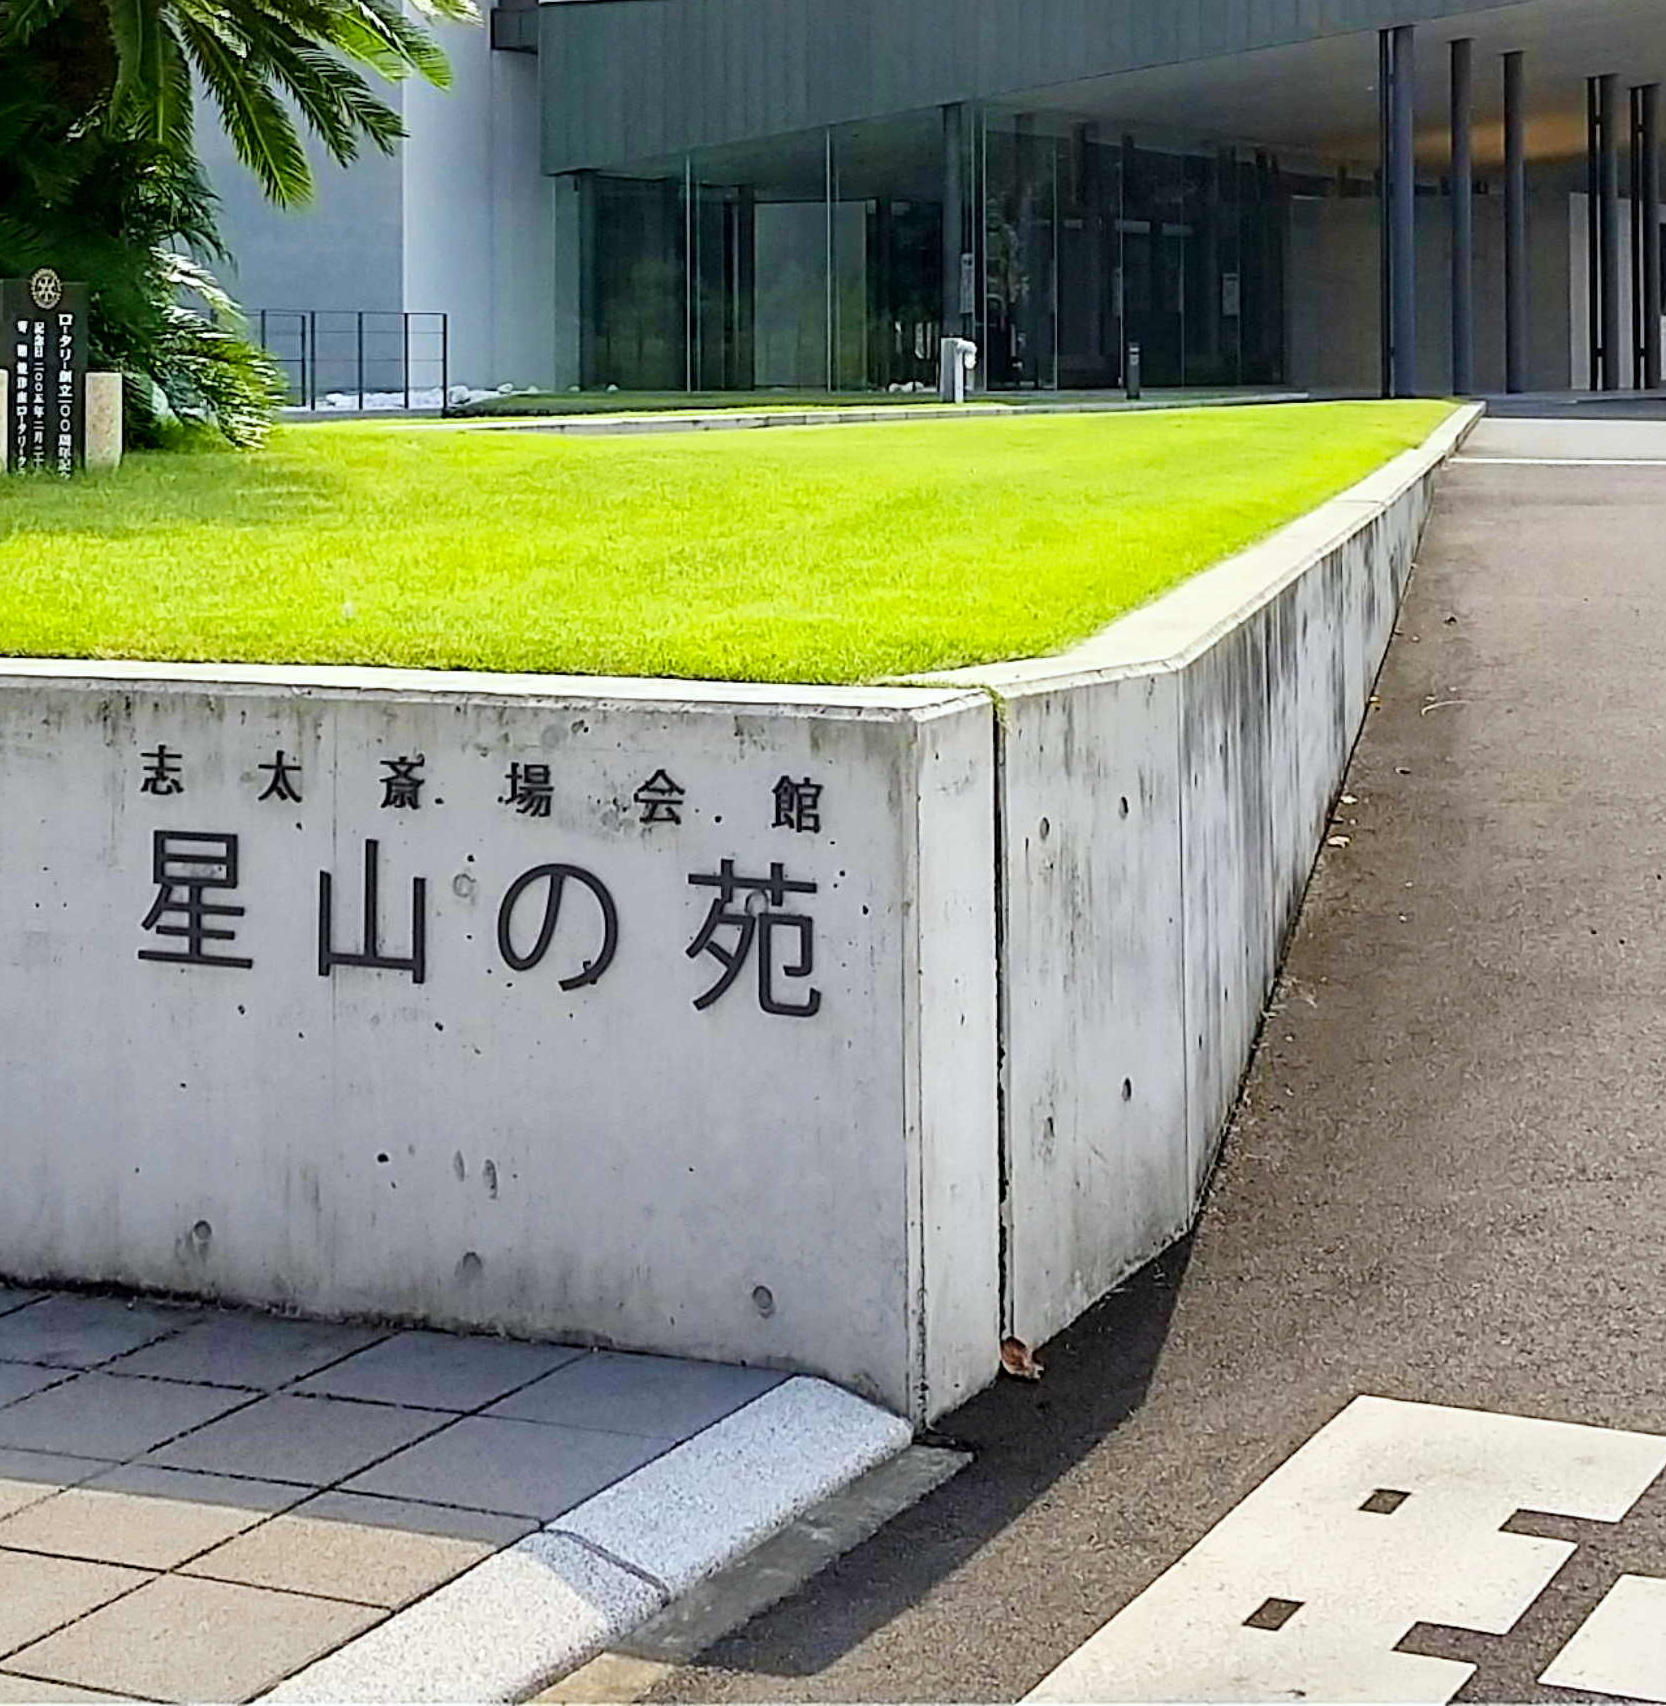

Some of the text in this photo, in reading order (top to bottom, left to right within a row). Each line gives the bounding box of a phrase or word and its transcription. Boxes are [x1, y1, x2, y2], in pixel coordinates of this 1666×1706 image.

[139, 744, 825, 834] 志太斎場会館
[137, 830, 823, 1018] 星山の苑
